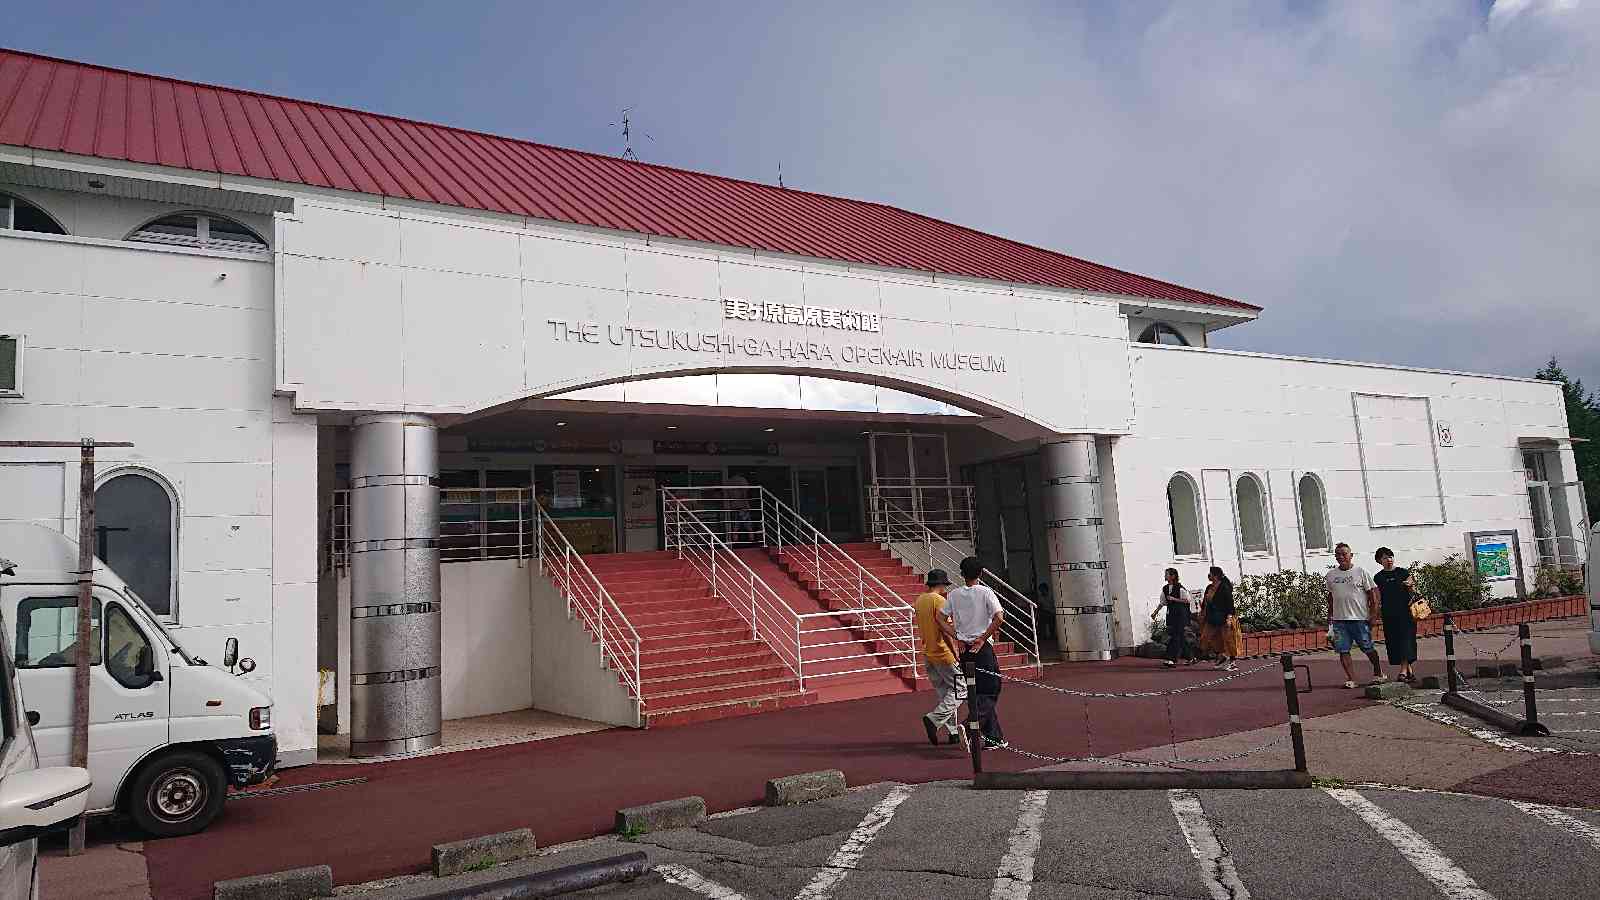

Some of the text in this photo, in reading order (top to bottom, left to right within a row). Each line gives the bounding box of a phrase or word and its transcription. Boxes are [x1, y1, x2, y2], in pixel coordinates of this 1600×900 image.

[547, 319, 600, 344] THE
[841, 345, 925, 368] OPEN-AIR
[930, 351, 1007, 373] MUSEUM
[113, 711, 154, 721] ATLAS
